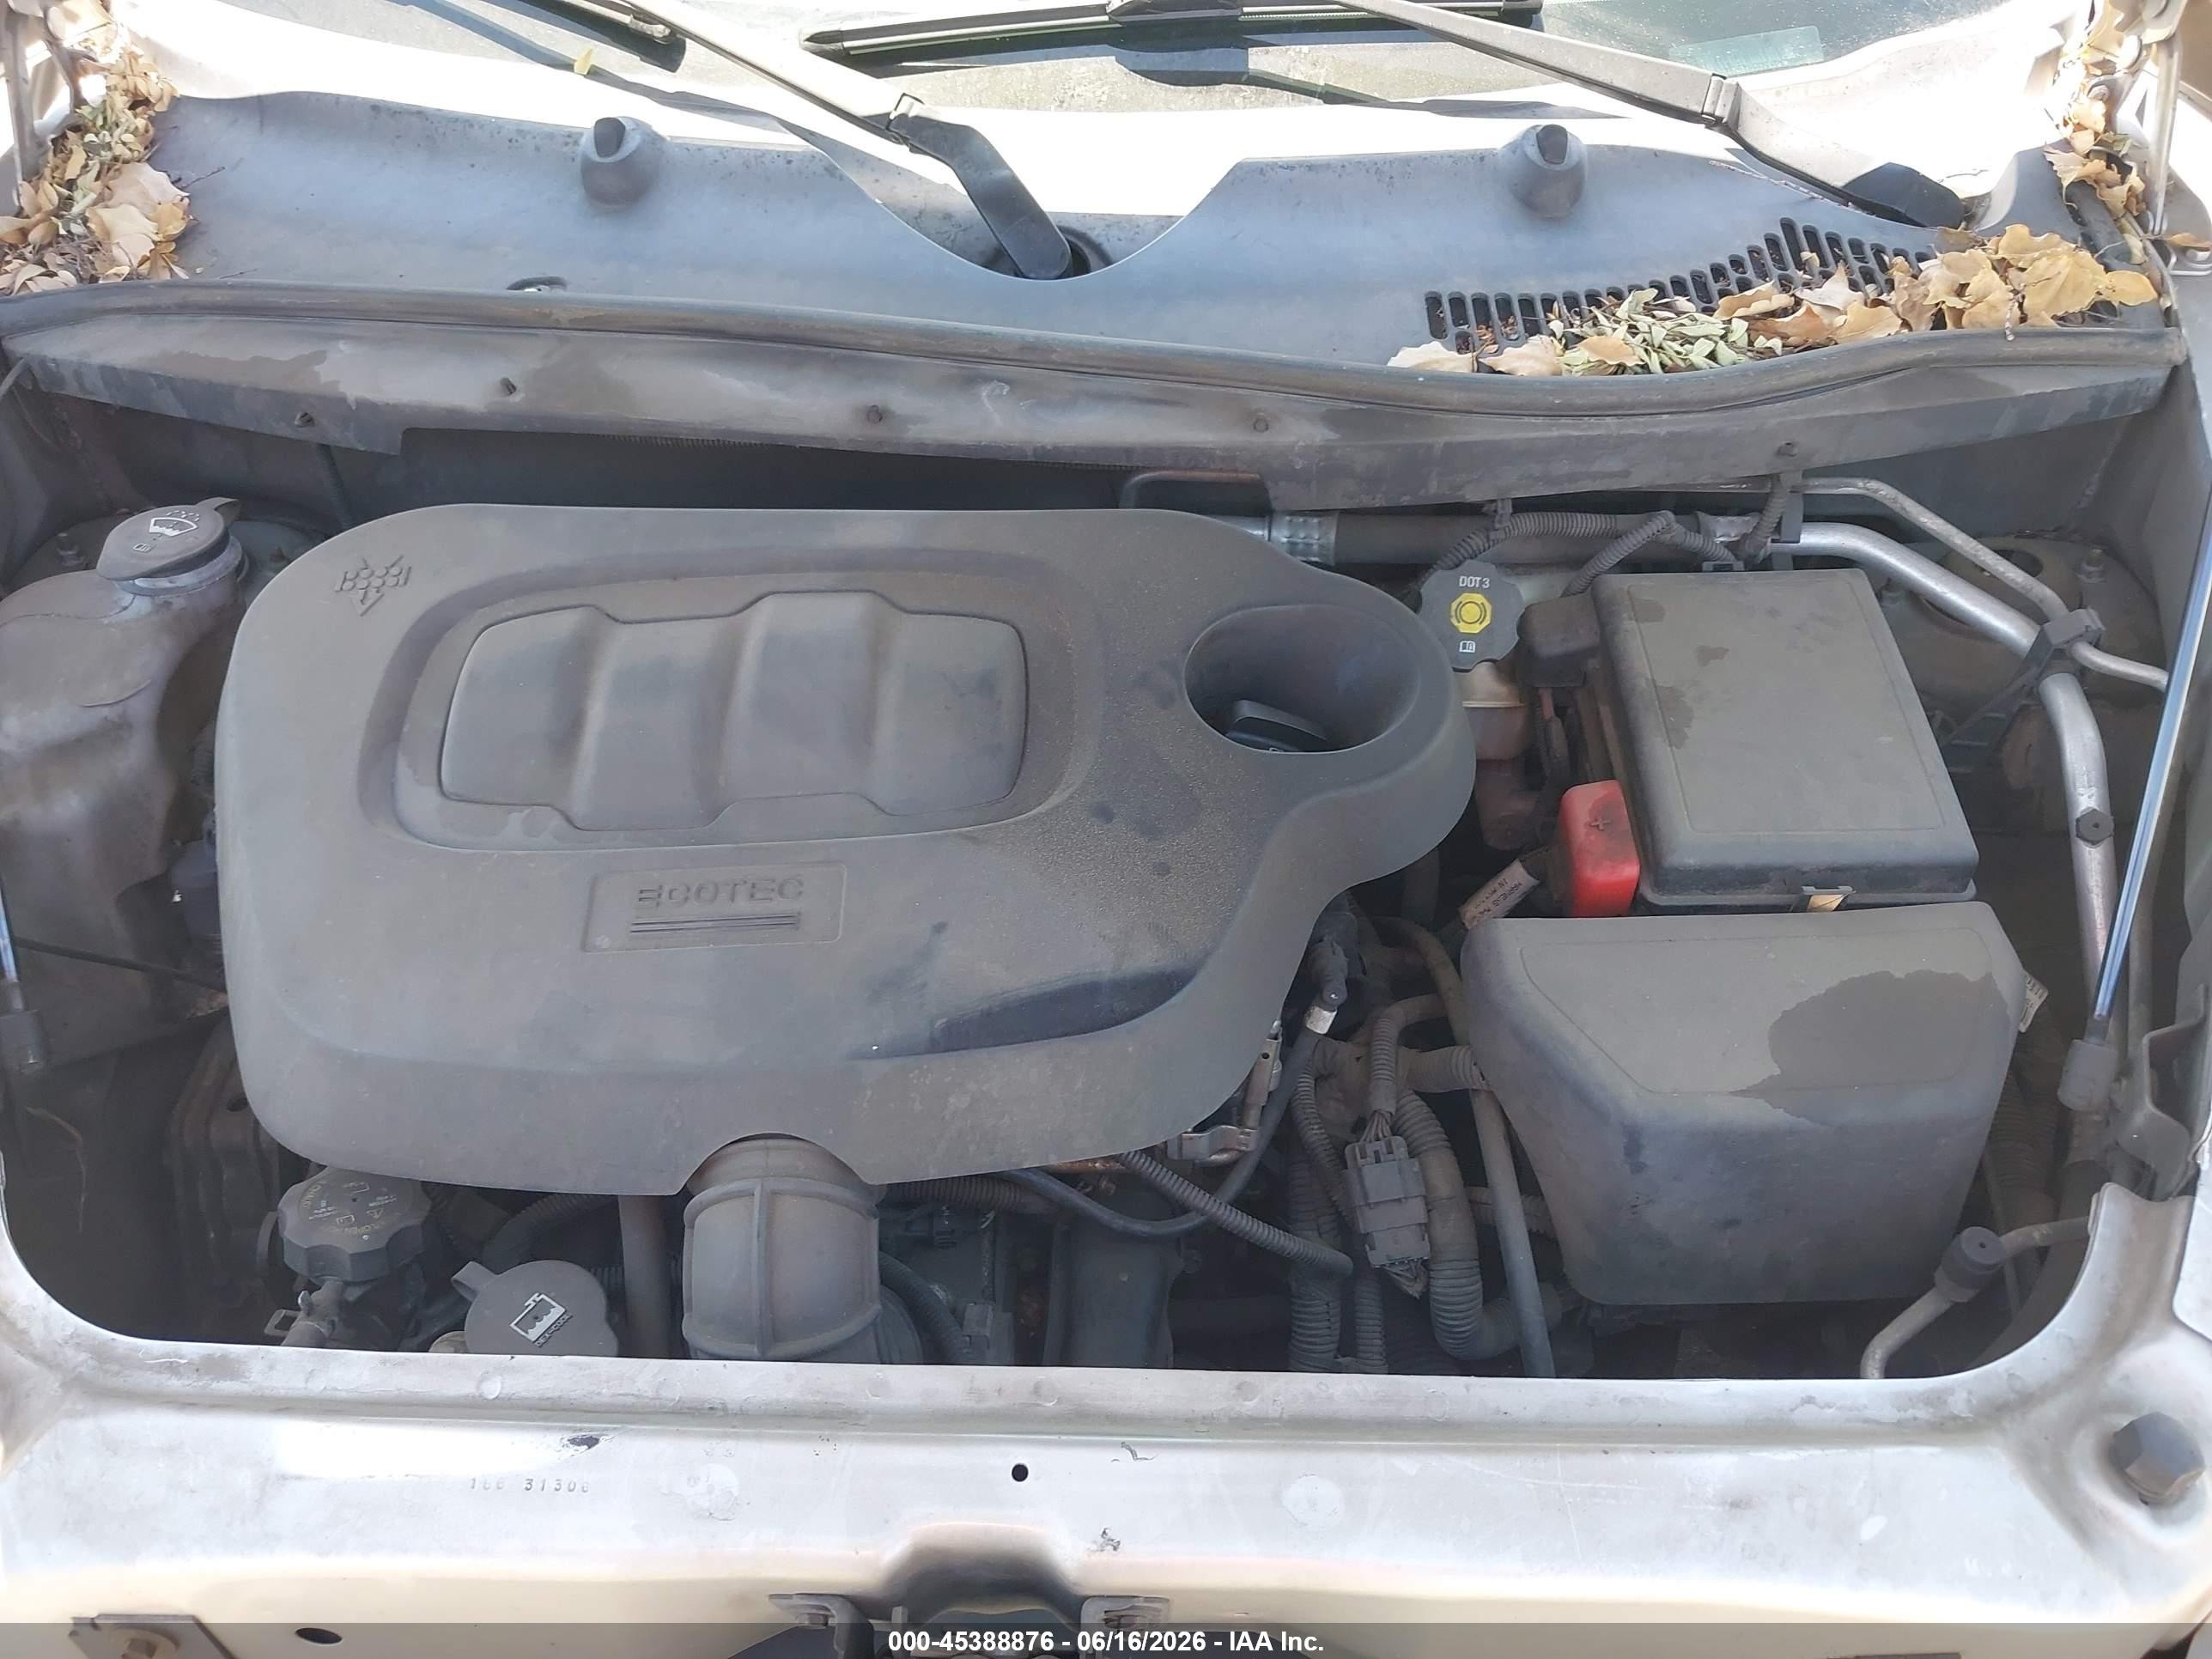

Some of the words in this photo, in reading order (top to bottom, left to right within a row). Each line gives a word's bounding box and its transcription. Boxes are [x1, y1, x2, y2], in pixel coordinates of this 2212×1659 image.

[1458, 575, 1482, 588] DOT
[1482, 577, 1491, 589] 3
[635, 878, 803, 909] ECOTEC
[533, 1311, 574, 1347] DEX-COOL
